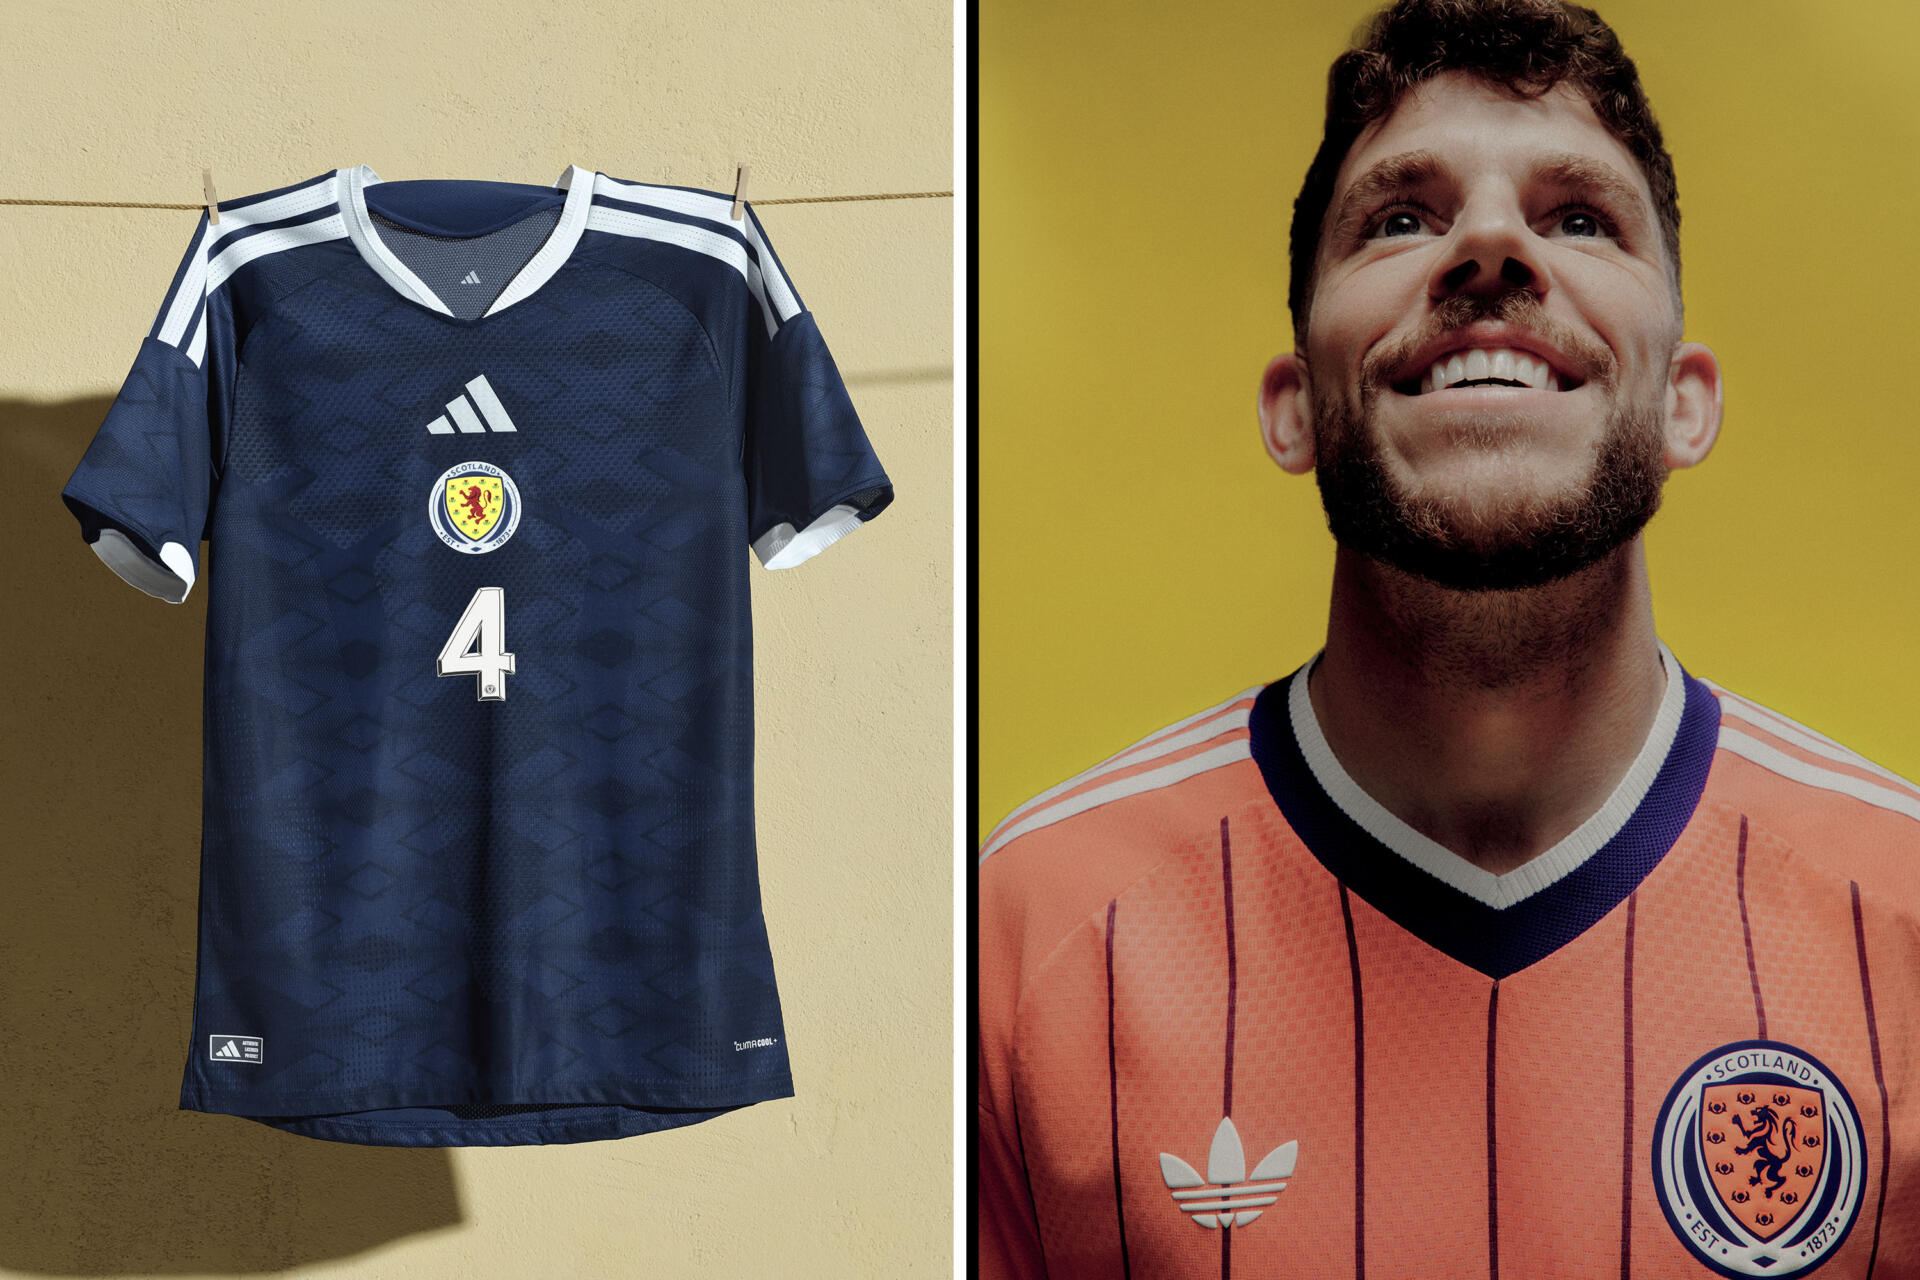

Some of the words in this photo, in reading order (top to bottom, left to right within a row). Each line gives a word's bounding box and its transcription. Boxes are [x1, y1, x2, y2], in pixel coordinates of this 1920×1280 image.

[450, 463, 497, 476] SCOTLAND
[442, 534, 455, 546] EST
[496, 531, 511, 546] 1873
[436, 586, 516, 702] 4
[1713, 1053, 1811, 1082] SCOTLAND
[1691, 1219, 1720, 1250] EST
[1806, 1221, 1837, 1254] 1873
